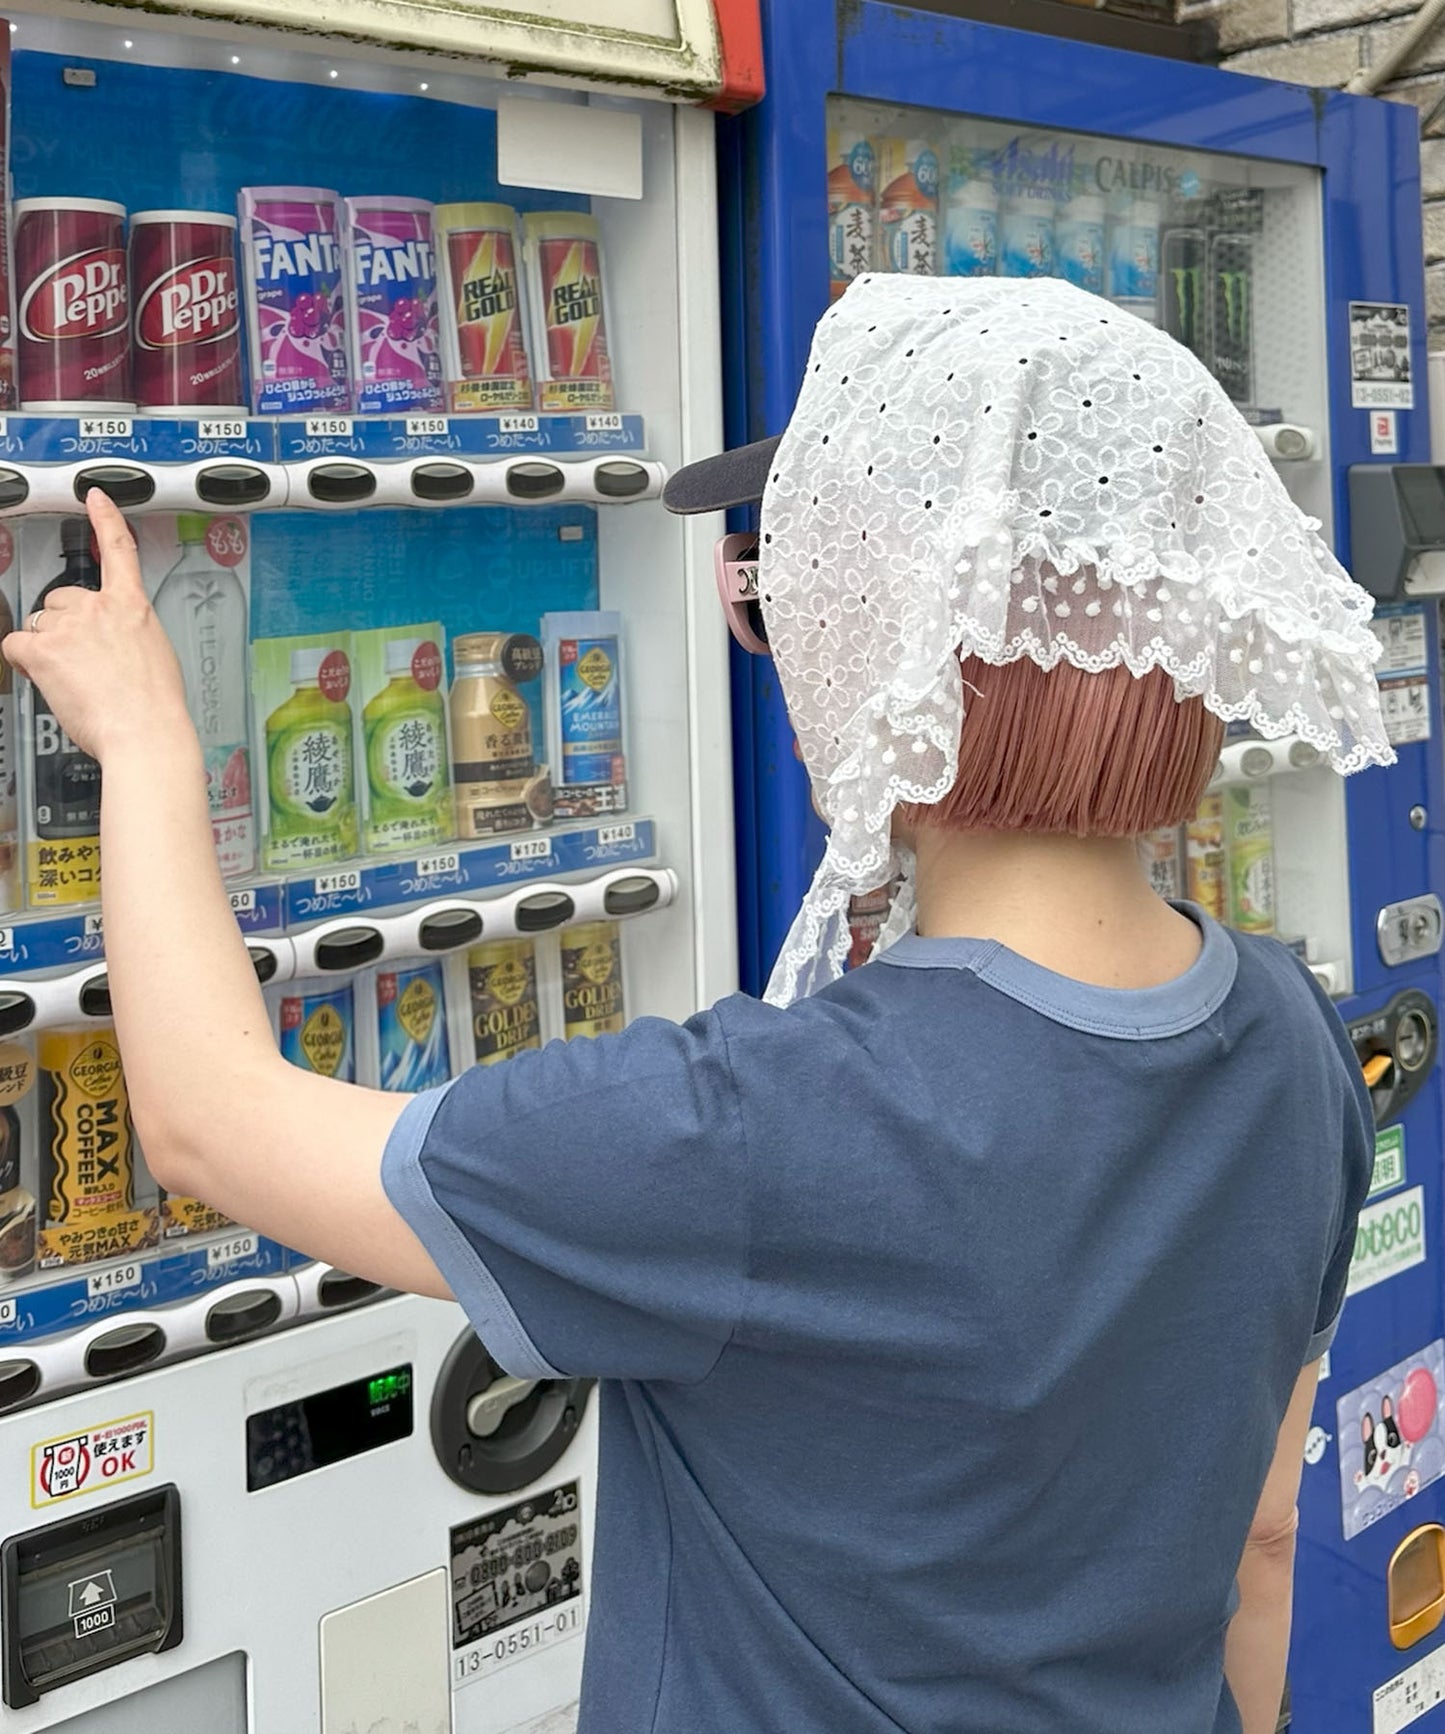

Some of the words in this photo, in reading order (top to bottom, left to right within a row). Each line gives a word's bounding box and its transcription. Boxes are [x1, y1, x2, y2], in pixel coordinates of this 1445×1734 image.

[1094, 156, 1176, 193] CALPIS
[84, 260, 121, 296] Dr
[190, 269, 228, 305] Dr
[463, 268, 515, 300] REAL
[52, 274, 127, 329] Peppe
[553, 275, 600, 306] REAL
[160, 283, 238, 337] Peppe
[465, 291, 514, 323] GOLD
[84, 421, 127, 435] ¥150
[202, 422, 242, 436] ¥150
[310, 420, 347, 433] ¥150
[411, 420, 445, 432] ¥150
[503, 418, 535, 430] ¥140
[590, 416, 619, 428] ¥140
[209, 528, 244, 555] もも
[399, 720, 430, 782] 綾鷹
[303, 732, 334, 795] 綾鷹
[602, 825, 633, 840] ¥140
[38, 845, 101, 867] 飲みや
[514, 841, 547, 856] ¥170
[421, 855, 456, 871] ¥150
[320, 873, 357, 890] ¥150
[231, 893, 249, 908] 60
[72, 1060, 120, 1078] GEORGIA
[77, 1103, 95, 1186] COFFEE
[96, 1099, 120, 1184] MAX
[59, 1219, 139, 1245] やみつきの甘さ
[212, 1239, 253, 1260] ¥150
[92, 1266, 136, 1289] ¥150
[93, 1430, 147, 1457] 使えます
[54, 1466, 75, 1480] 1000
[101, 1451, 136, 1478] OK
[59, 1479, 69, 1489] 円
[80, 1611, 109, 1632] 1000
[458, 1609, 577, 1677] 13-0551-01
